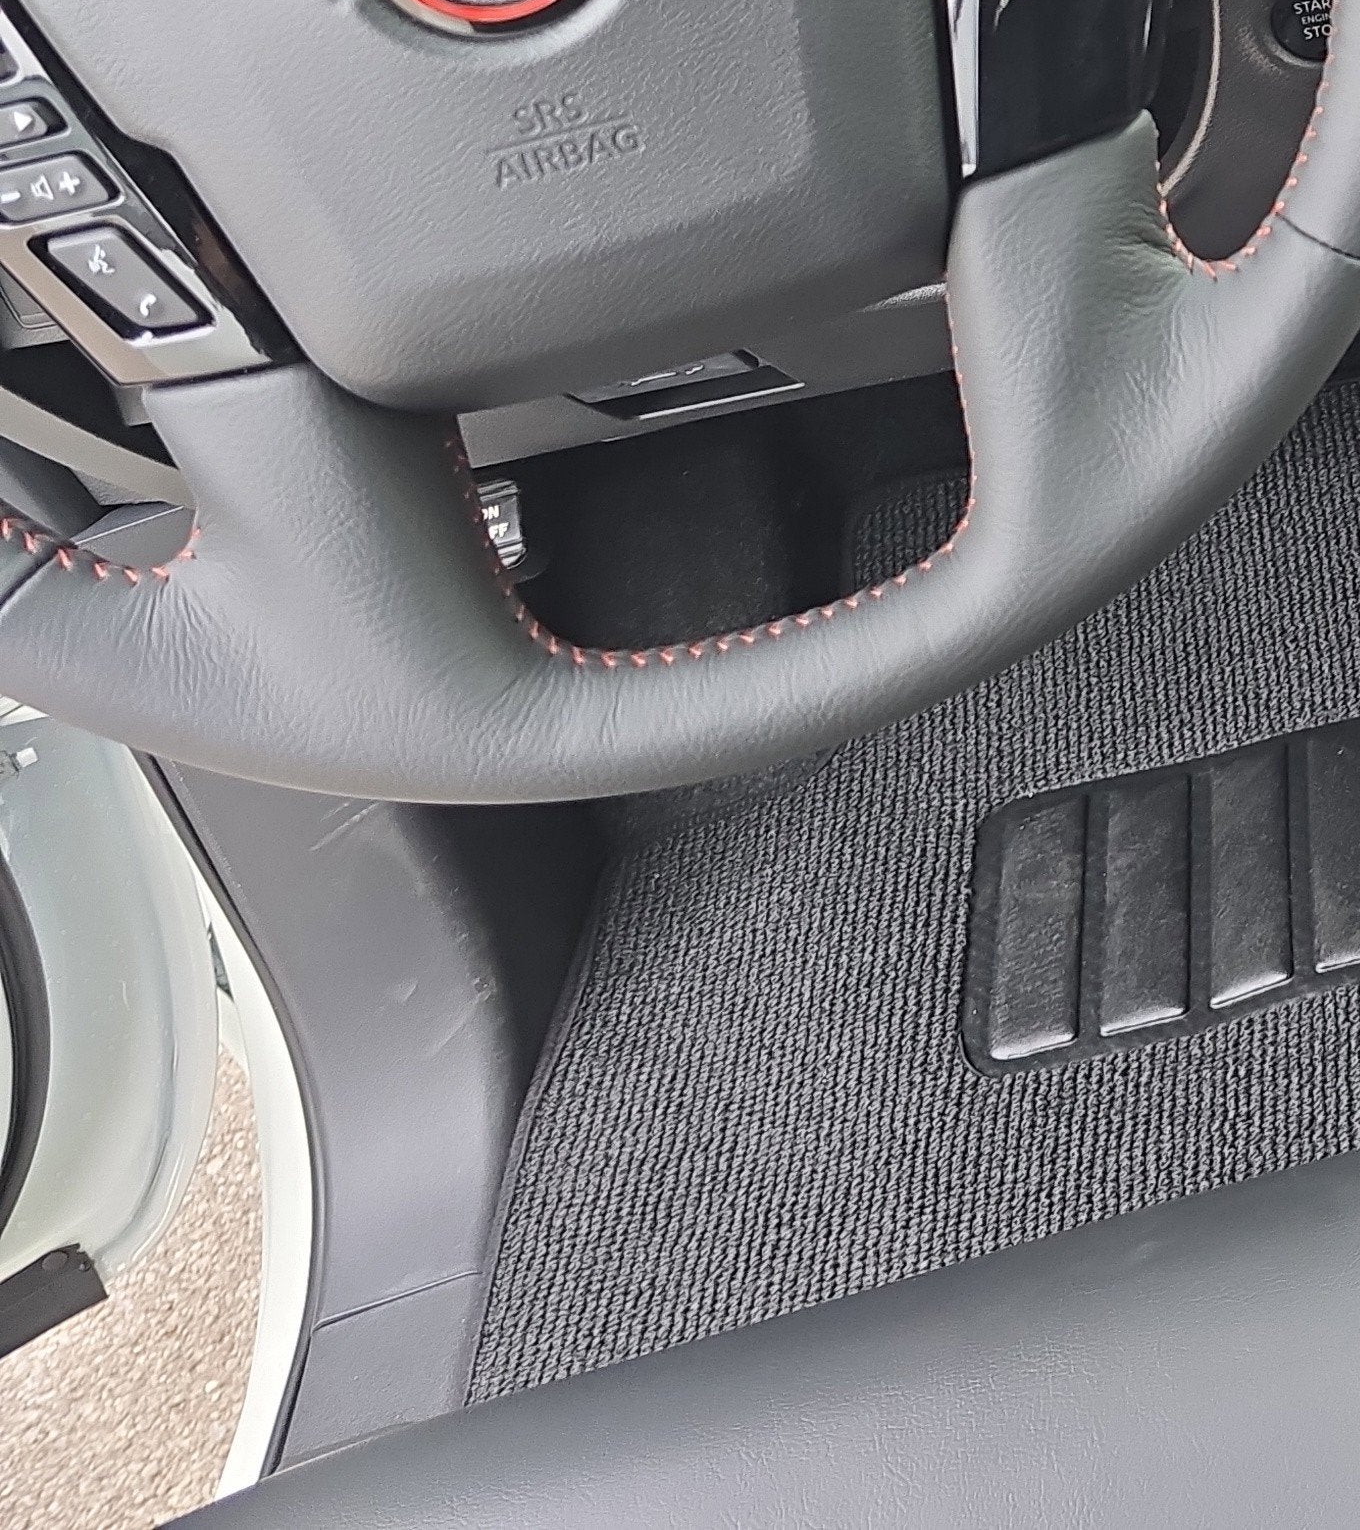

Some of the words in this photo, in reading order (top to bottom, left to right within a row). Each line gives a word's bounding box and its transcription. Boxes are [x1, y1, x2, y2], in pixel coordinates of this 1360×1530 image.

[1303, 24, 1333, 40] STO
[511, 92, 586, 136] SRS
[494, 123, 641, 189] AIRBAG
[488, 522, 509, 540] FF
